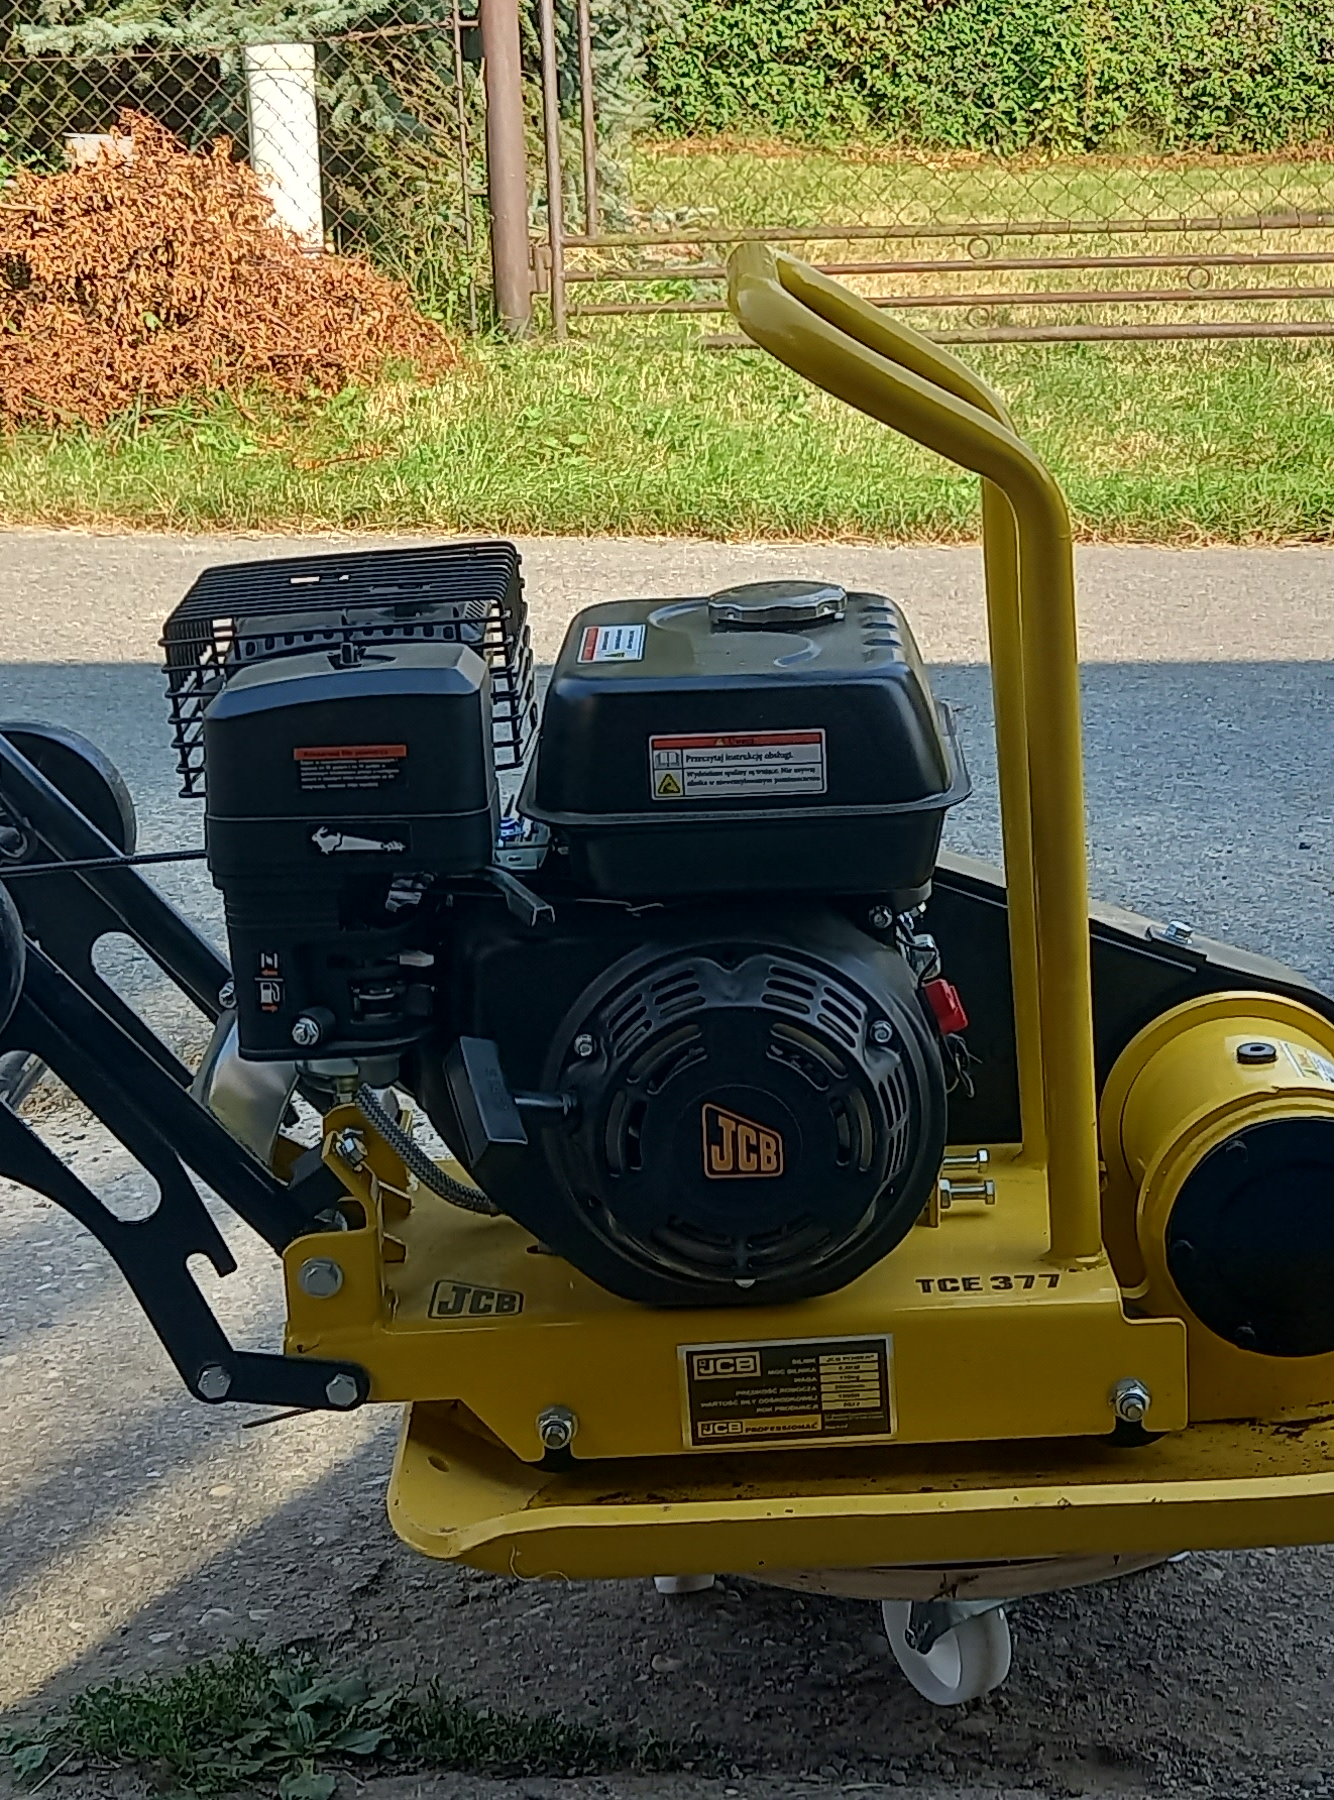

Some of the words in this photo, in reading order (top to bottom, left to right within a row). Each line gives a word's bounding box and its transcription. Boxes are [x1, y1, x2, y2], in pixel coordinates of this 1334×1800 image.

[686, 752, 724, 763] Przeczytaj
[725, 751, 762, 762] instrukcję
[711, 1114, 778, 1171] JCB
[915, 1276, 983, 1293] TCE
[990, 1273, 1060, 1290] 377
[437, 1285, 517, 1315] JCB
[699, 1357, 755, 1374] JCB
[702, 1422, 742, 1435] JCB
